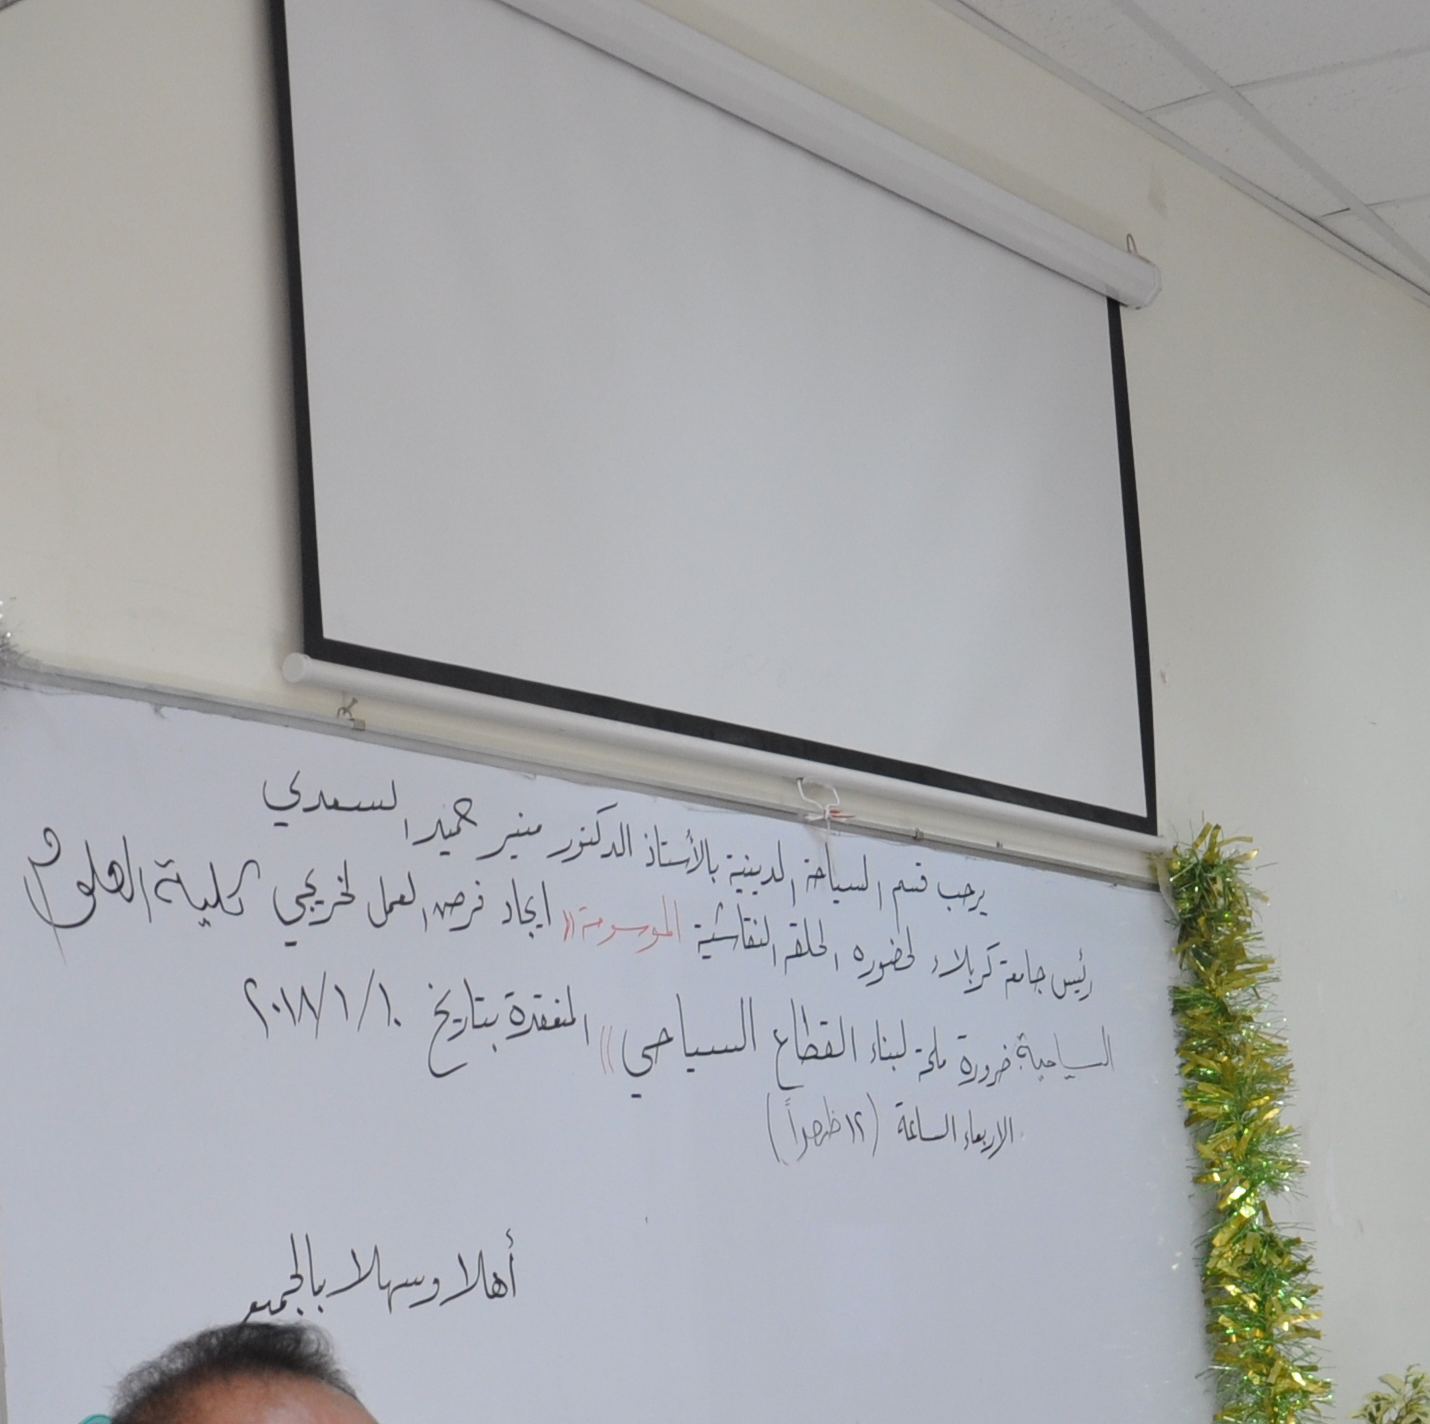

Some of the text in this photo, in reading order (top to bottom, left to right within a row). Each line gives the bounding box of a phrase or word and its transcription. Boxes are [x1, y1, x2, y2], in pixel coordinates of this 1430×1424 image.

[262, 770, 988, 934] يرحب قسم السياحة الدينية بالأستاذ الدكتور منير حميد السعدي
[23, 827, 152, 965] العلوم
[154, 859, 261, 927] كلية
[273, 859, 356, 946] لخريجي
[367, 871, 428, 932] العمل
[432, 880, 484, 933] فرص
[694, 901, 777, 967] النقاشية
[784, 917, 839, 975] الحلقة
[853, 926, 916, 987] لحضوره
[930, 940, 1001, 995] كربلاء
[1001, 949, 1046, 1000] جامعة
[1048, 947, 1093, 1002] رئيس
[428, 977, 499, 1079] بتاريخ
[505, 983, 590, 1046] المنعقدة
[773, 998, 857, 1091] القطاع
[870, 1018, 907, 1072] لبناء
[622, 992, 754, 1099] السياحي
[914, 1026, 947, 1083] ملحة
[957, 1033, 1011, 1088] ضرورة
[894, 1101, 956, 1143] الساعة
[964, 1108, 1014, 1161] الاربعاء
[438, 1228, 517, 1308] أهلا
